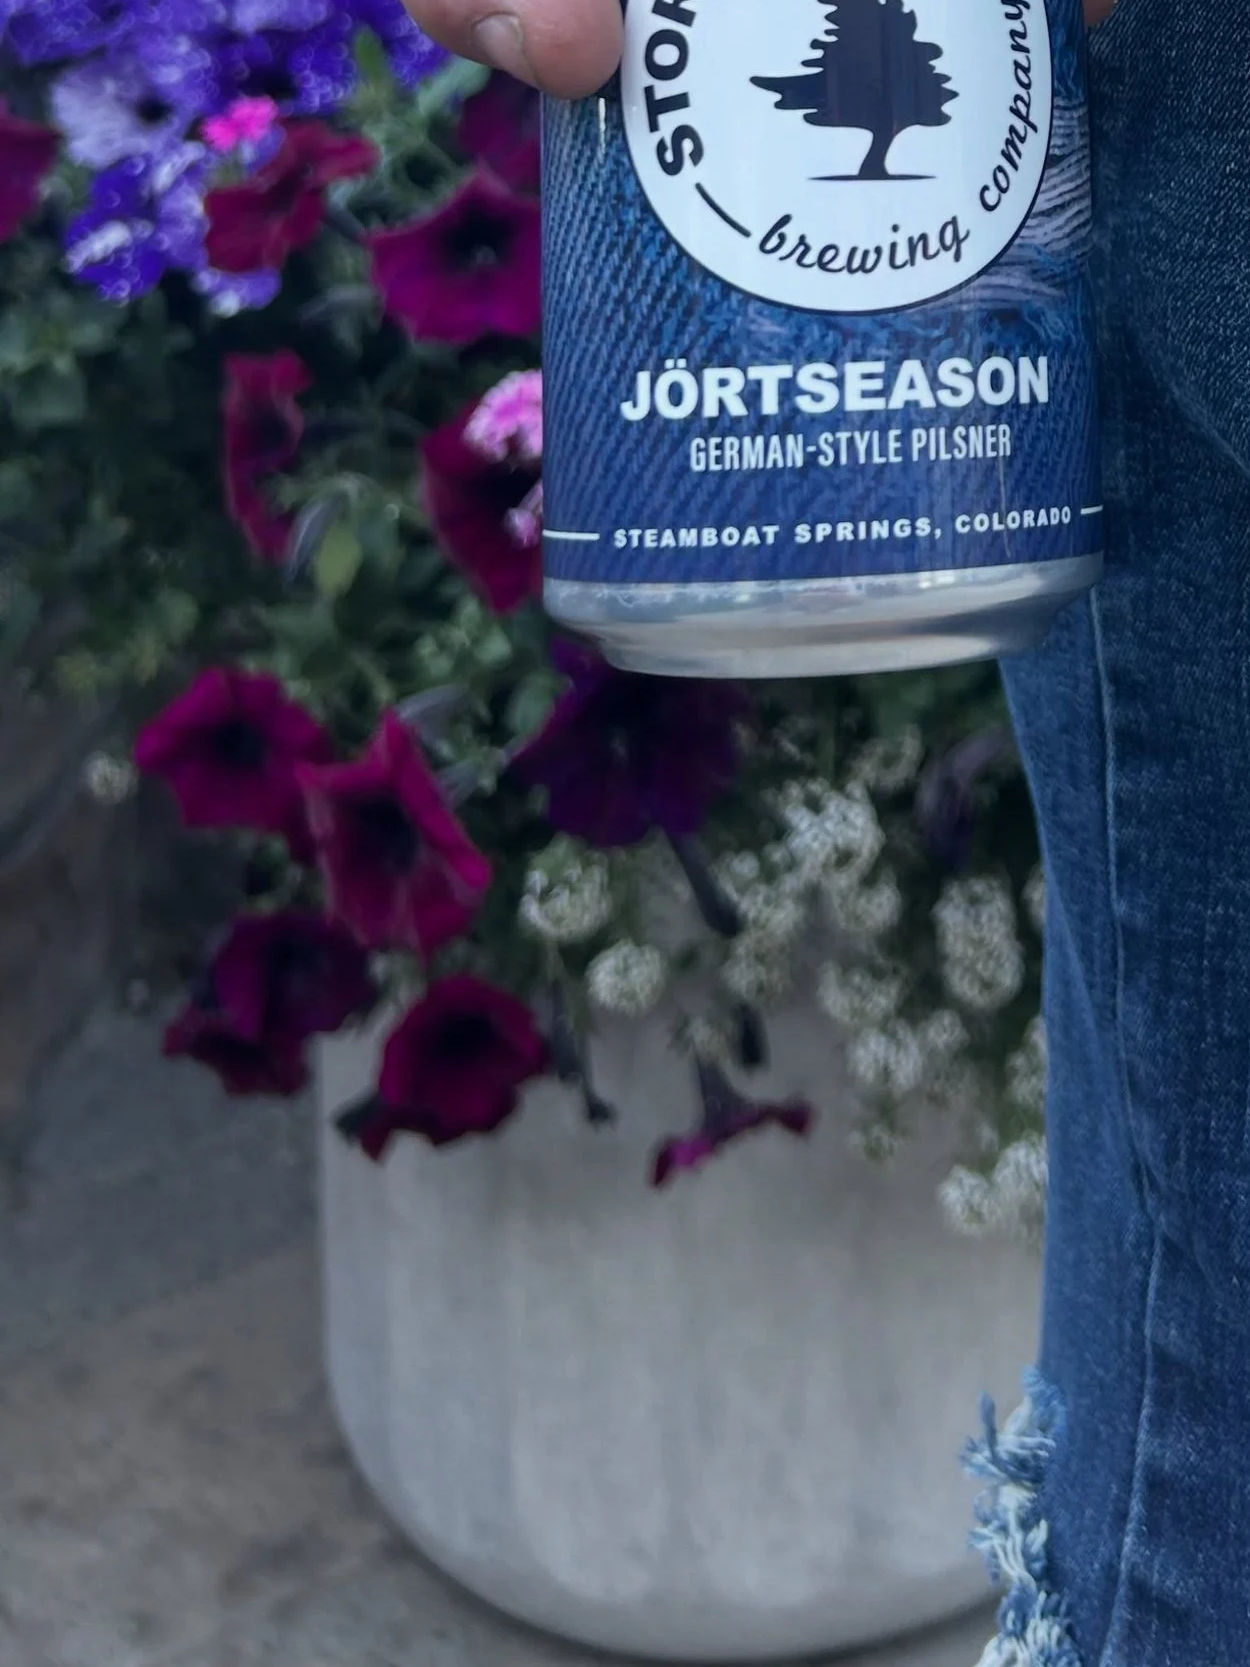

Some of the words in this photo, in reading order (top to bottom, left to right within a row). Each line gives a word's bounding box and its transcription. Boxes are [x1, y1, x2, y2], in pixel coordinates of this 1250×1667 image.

[758, 214, 970, 274] brewing
[620, 356, 1050, 422] JÖRTSEASON
[689, 428, 903, 472] GERMAN-STYLE
[911, 423, 1012, 463] PILSNER
[613, 525, 780, 549] STEAMBOAT
[793, 518, 942, 544] SPRINGS,
[954, 505, 1073, 534] COLORADO
